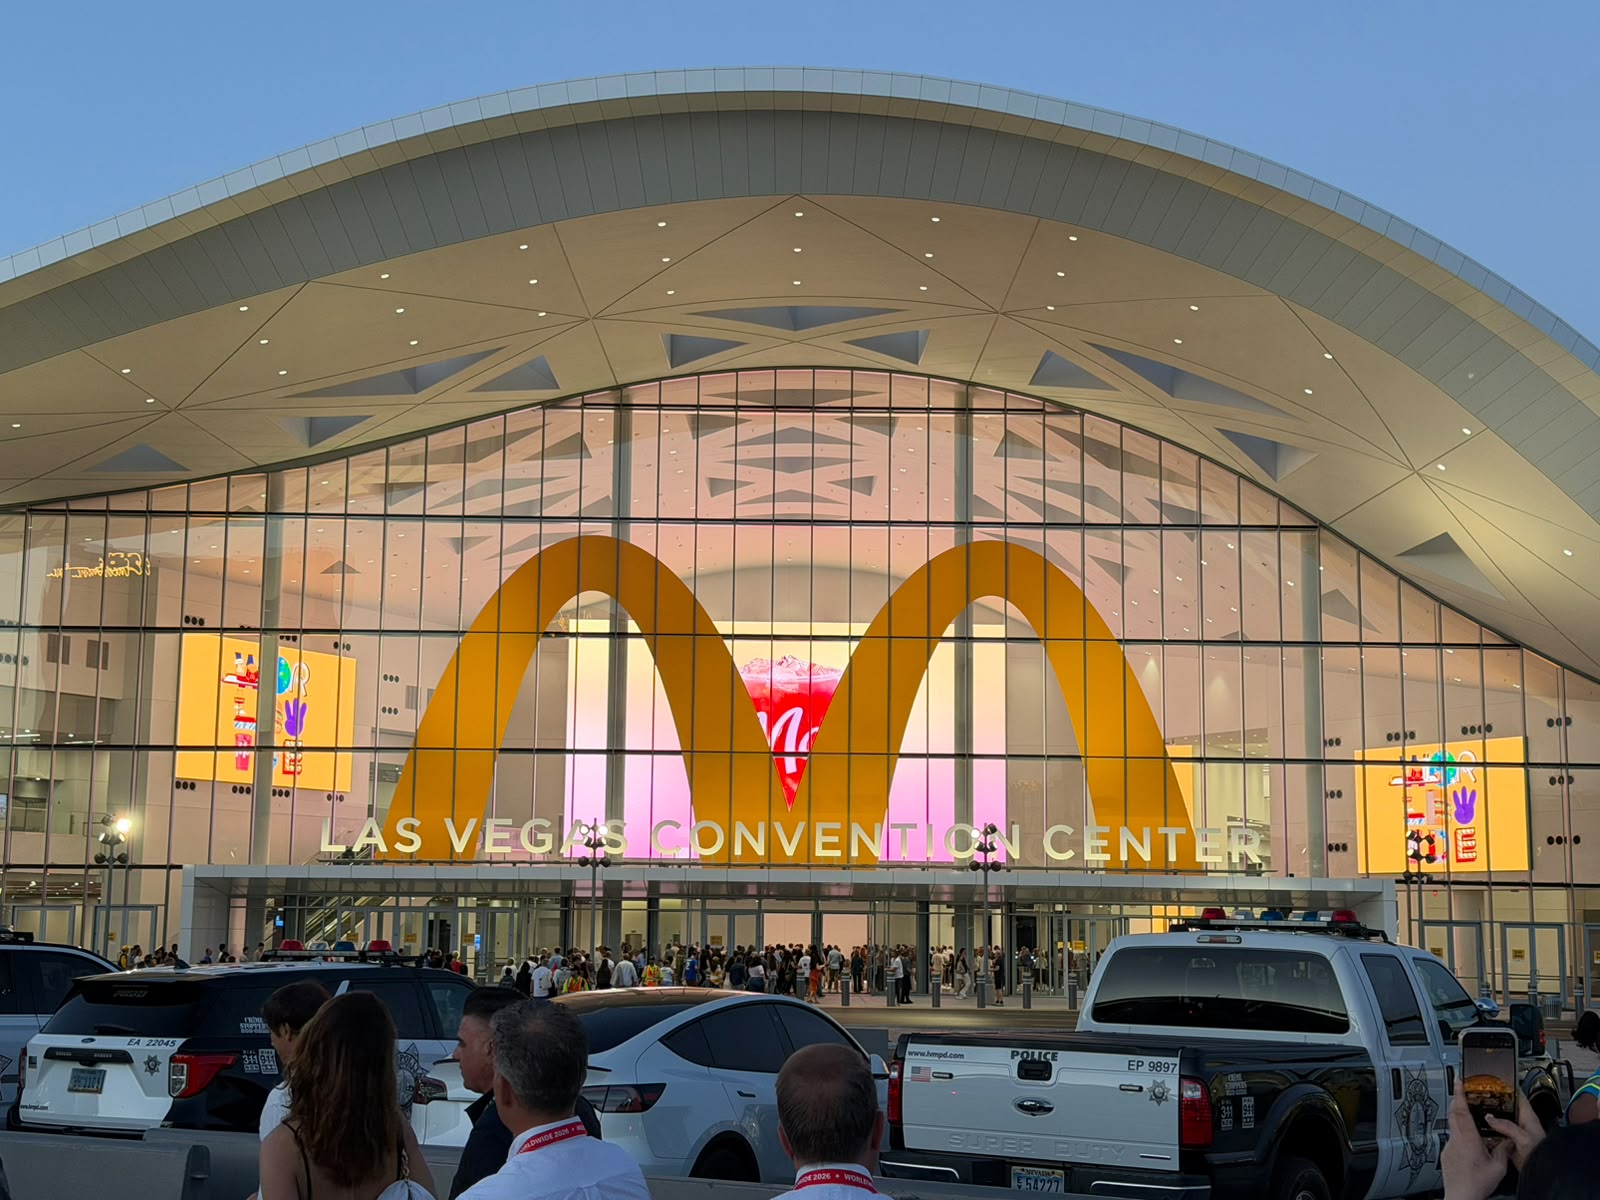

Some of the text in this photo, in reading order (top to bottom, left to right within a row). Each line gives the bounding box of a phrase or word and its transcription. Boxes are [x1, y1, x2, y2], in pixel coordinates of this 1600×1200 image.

[320, 817, 1262, 864] LAS VEGAS CONVENTION CENTER
[127, 1038, 177, 1047] EA 22045
[908, 1049, 965, 1060] www.lvmpd.com
[1010, 1049, 1059, 1062] POLICE
[1127, 1060, 1177, 1073] EP 9897
[553, 1128, 570, 1138] 2026
[947, 1133, 1127, 1161] SUPER DUTY
[813, 1173, 831, 1181] 2026
[1024, 1168, 1050, 1177] NEVADA
